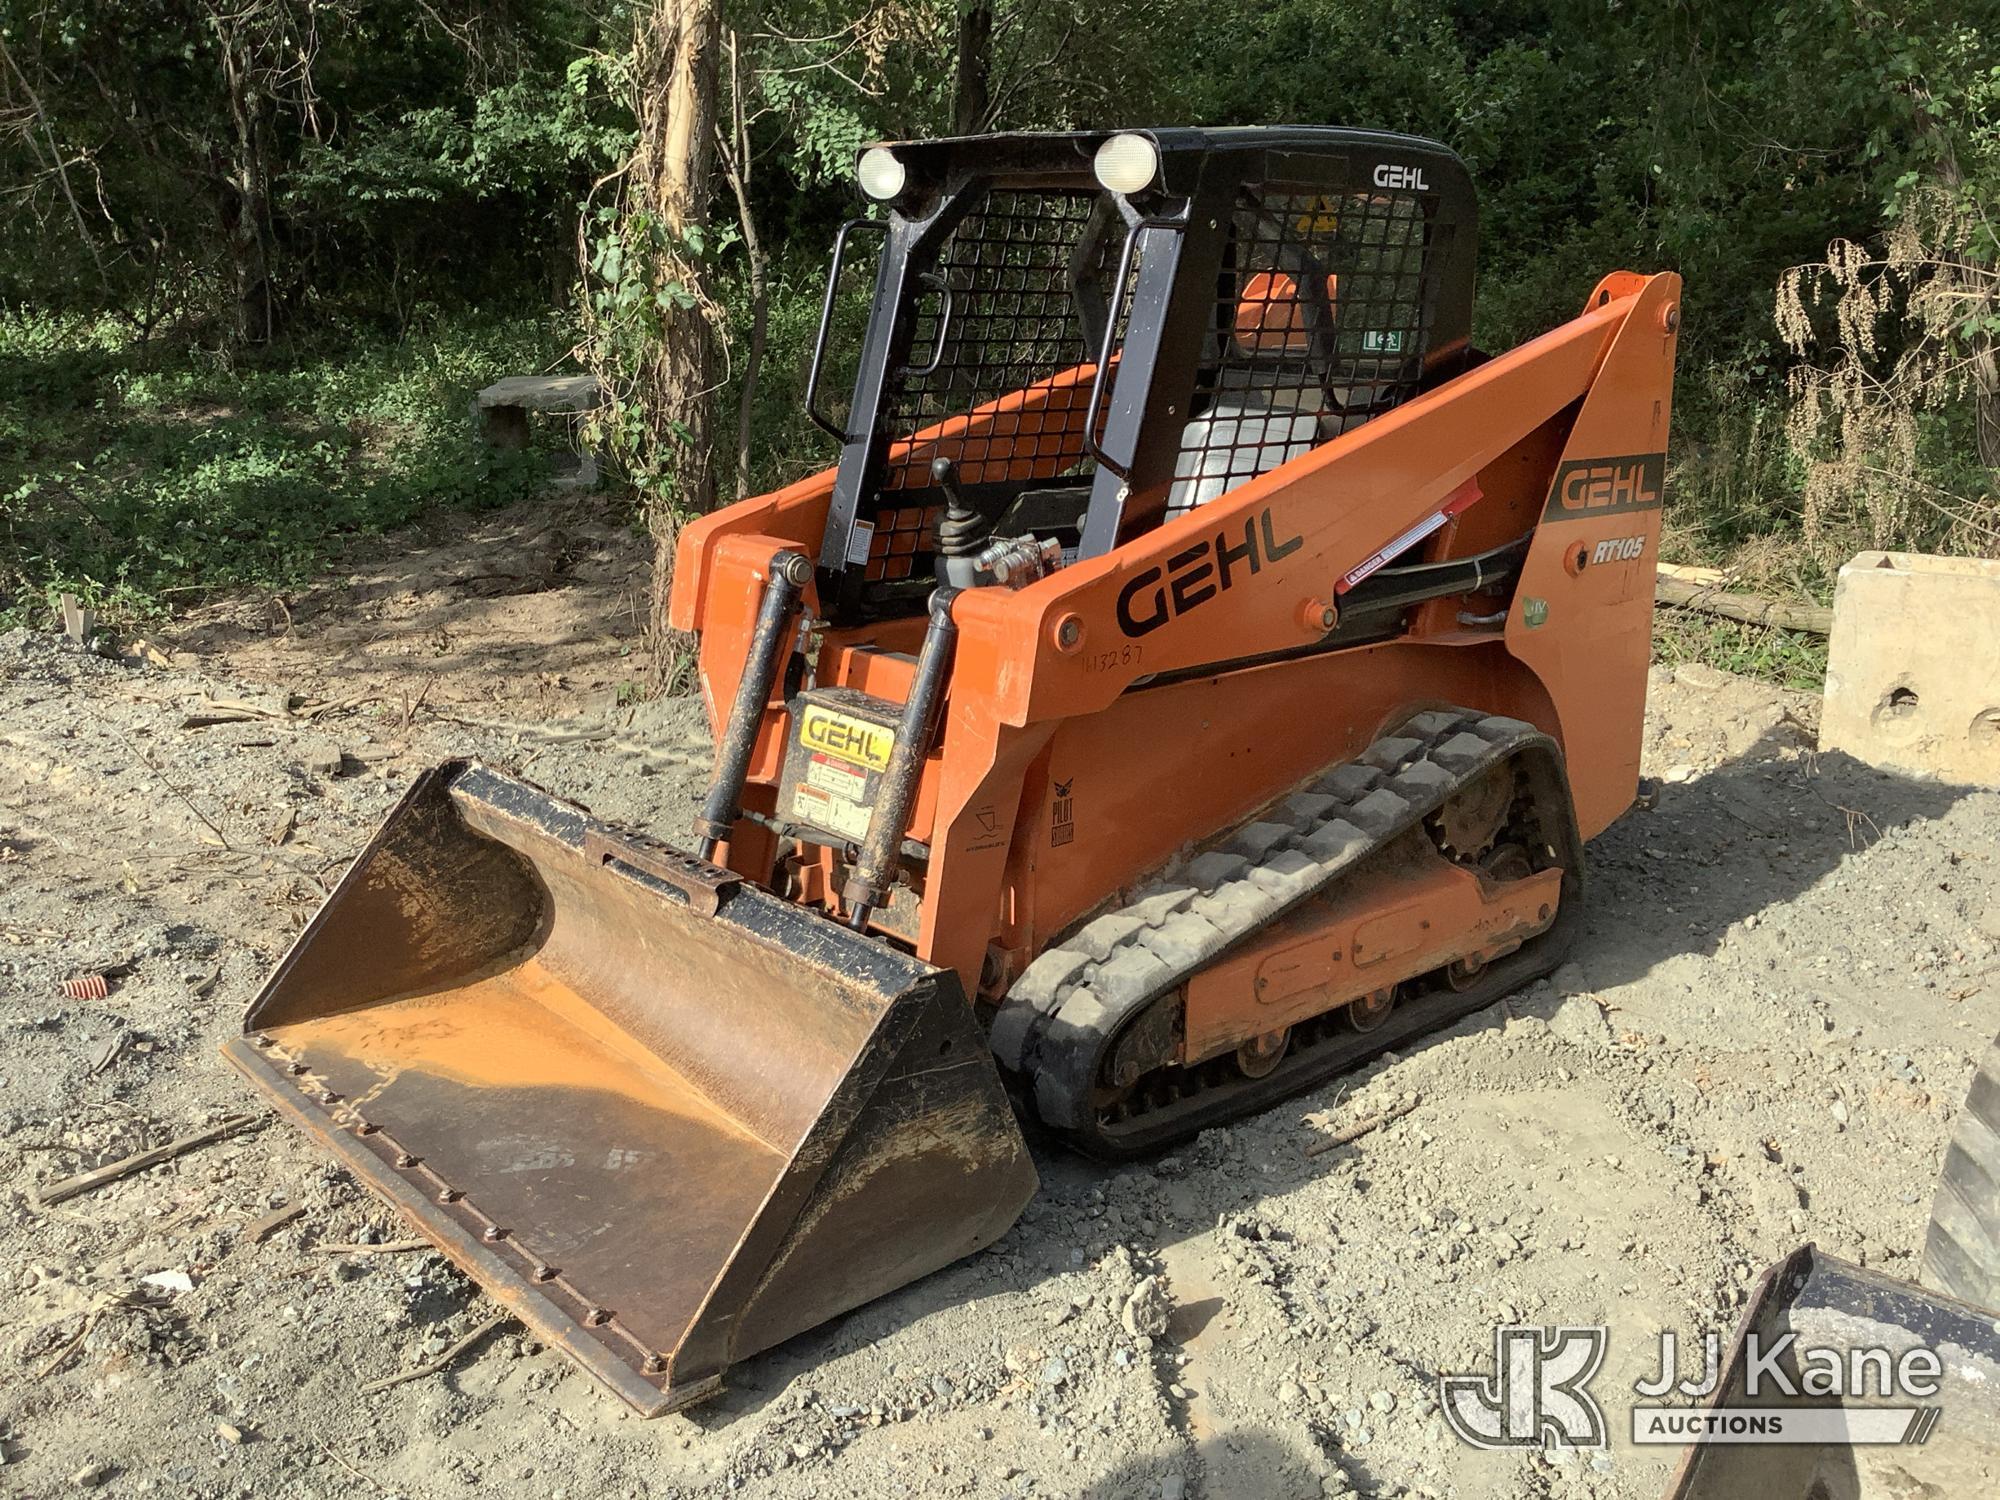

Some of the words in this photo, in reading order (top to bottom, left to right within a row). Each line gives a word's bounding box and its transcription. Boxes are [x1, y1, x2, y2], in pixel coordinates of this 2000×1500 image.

[1373, 163, 1429, 191] GEHL
[1560, 463, 1656, 511] GEHL
[1592, 535, 1647, 566] RT105
[1116, 506, 1304, 638] GEHL
[808, 714, 882, 762] GEHL
[1052, 797, 1073, 826] PILOT
